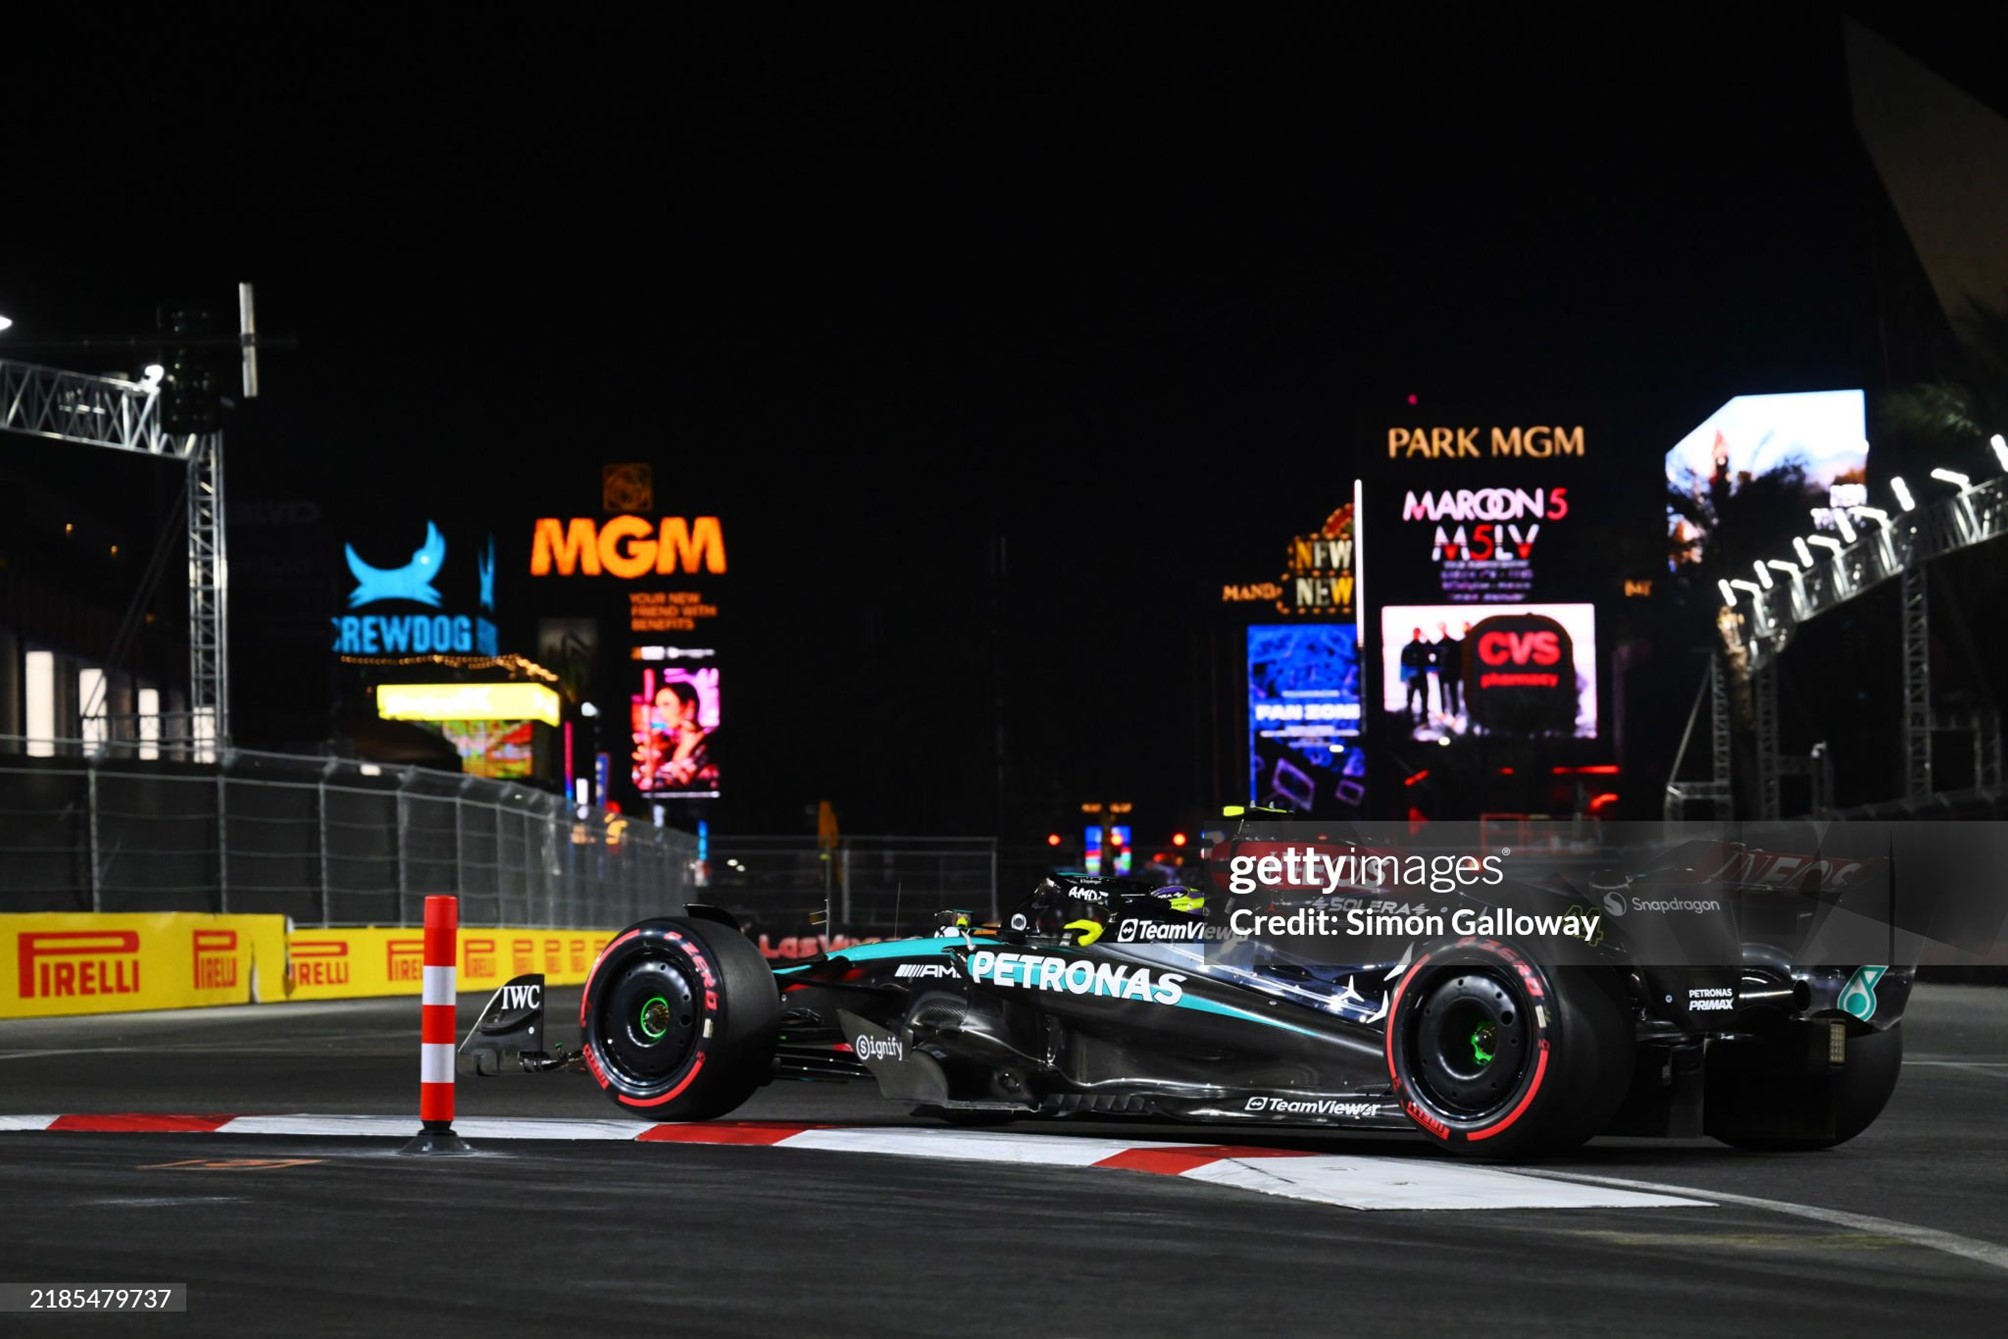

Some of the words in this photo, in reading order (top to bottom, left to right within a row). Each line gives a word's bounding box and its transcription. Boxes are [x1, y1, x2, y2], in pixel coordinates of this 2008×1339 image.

[1387, 427, 1480, 458] PARK
[1491, 425, 1584, 457] MGM
[1402, 487, 1544, 521] MAROON
[1546, 487, 1568, 520] 5
[531, 515, 727, 578] MGM
[1296, 577, 1354, 607] NEW
[332, 615, 472, 653] REWDOG
[1478, 630, 1562, 667] CVS
[1632, 896, 1721, 914] Snapdragon
[18, 931, 139, 998] PIRELLI
[193, 930, 237, 989] PIRELLI
[972, 950, 1187, 1006] PETRONAS
[1688, 988, 1733, 998] PETRONAS
[501, 984, 540, 1010] IWC
[1688, 998, 1734, 1011] PRIMAX
